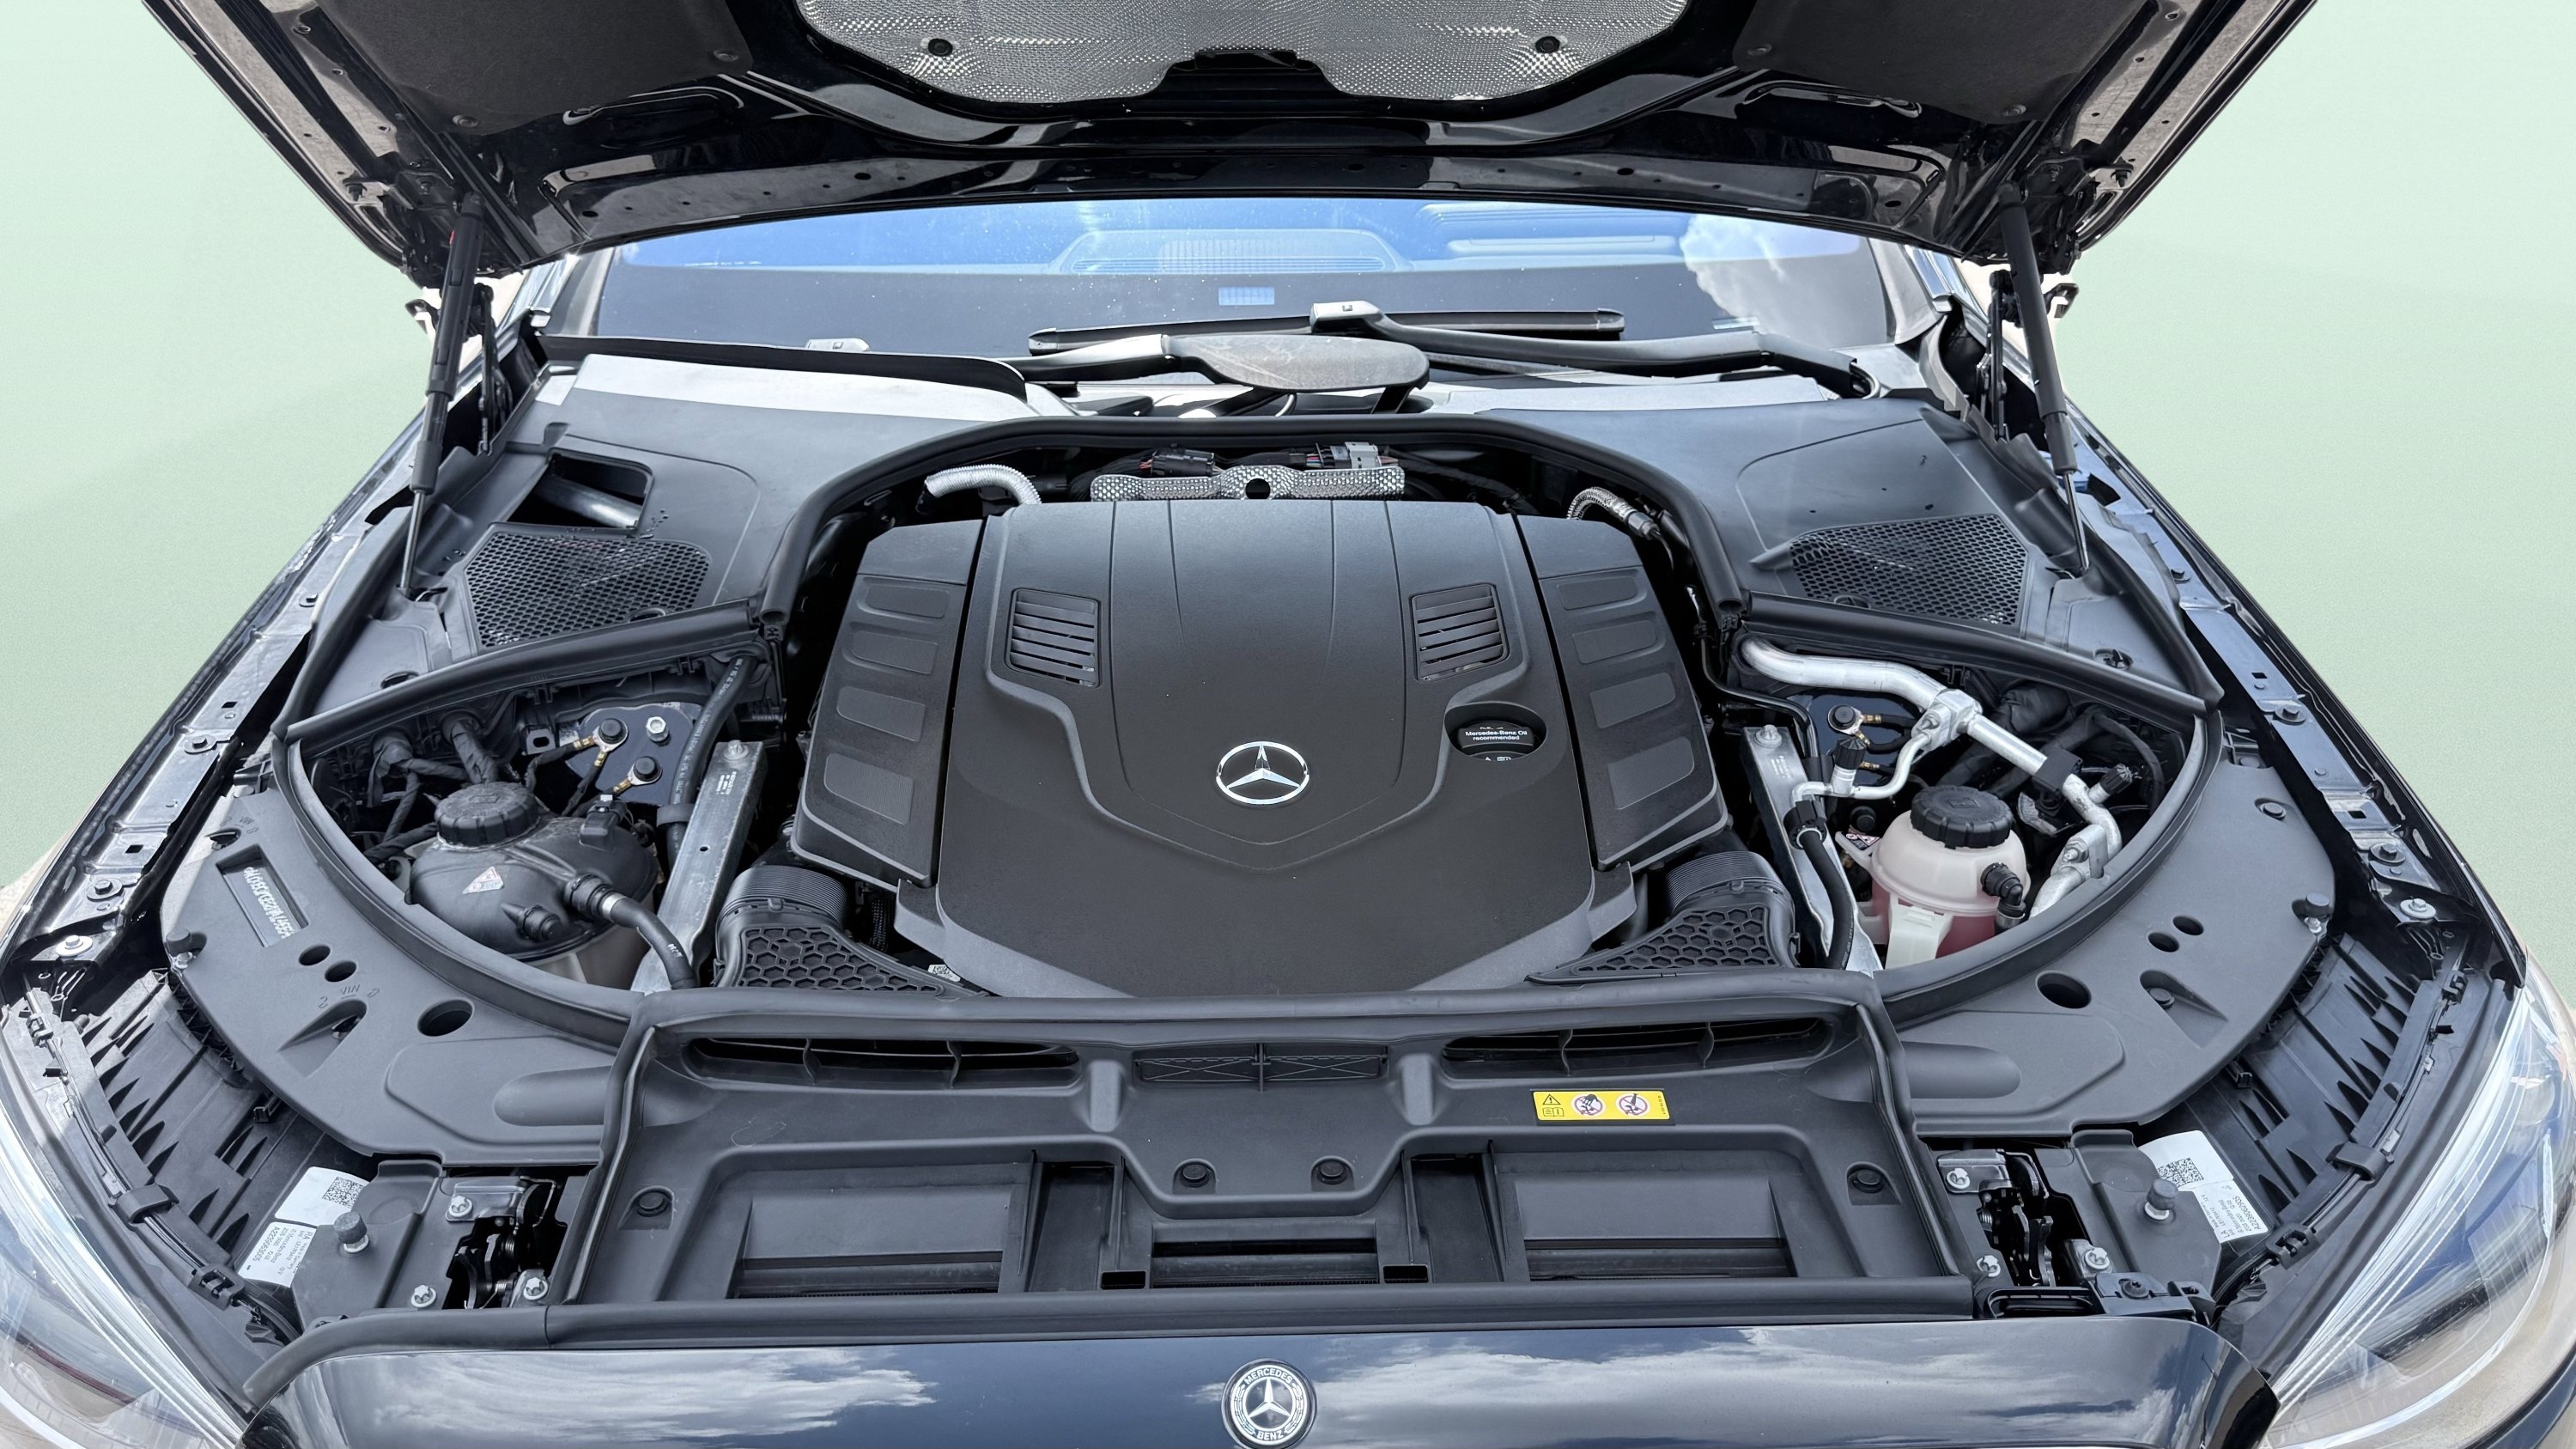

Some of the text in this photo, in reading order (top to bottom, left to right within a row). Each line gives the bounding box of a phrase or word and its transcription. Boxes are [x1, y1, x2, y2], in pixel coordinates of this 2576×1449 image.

[340, 983, 361, 995] VIN
[302, 1231, 313, 1239] RA
[2220, 1229, 2229, 1238] LA
[1243, 1367, 1293, 1385] MERCEDES
[1256, 1429, 1285, 1441] BENZ
